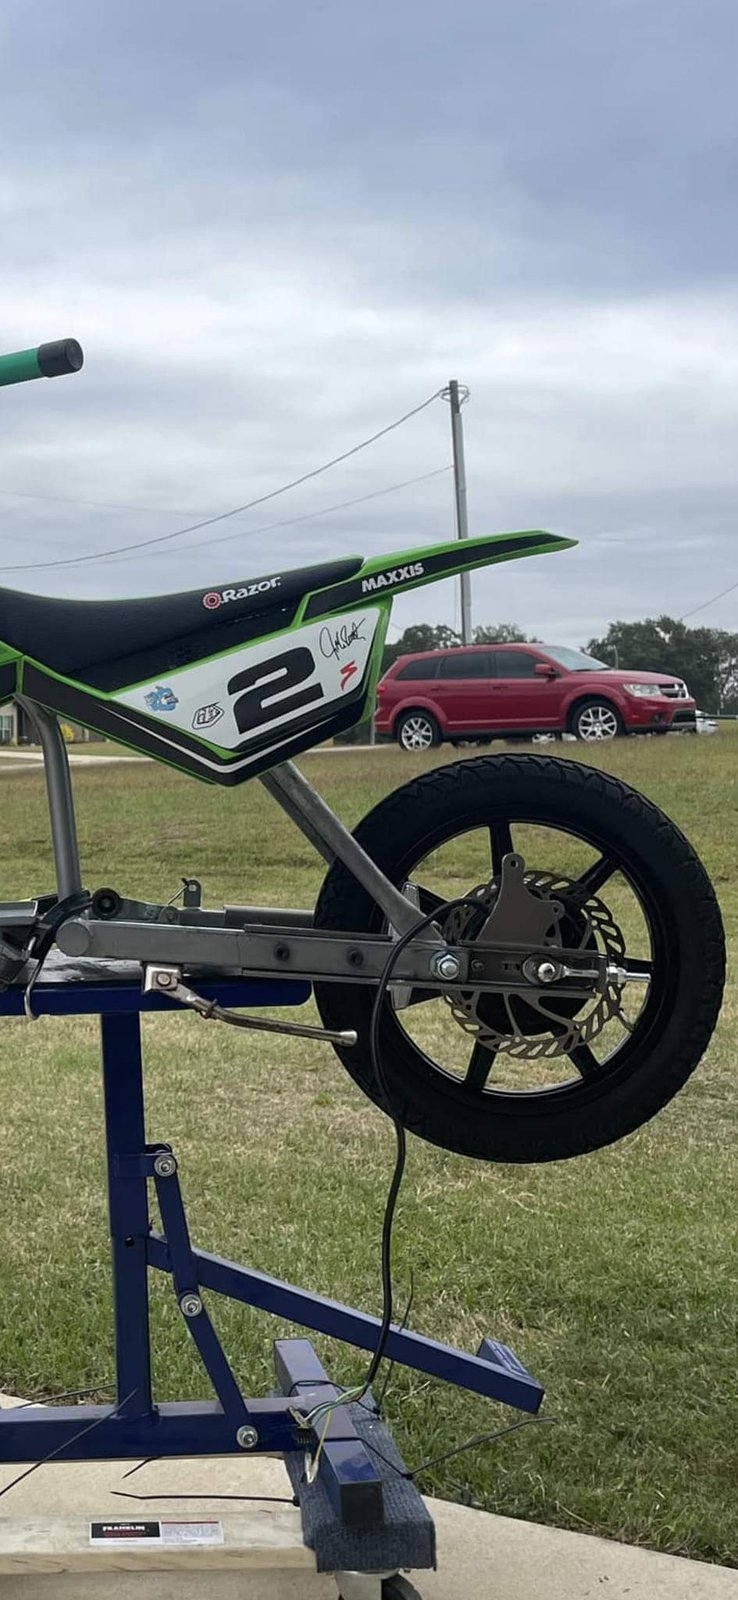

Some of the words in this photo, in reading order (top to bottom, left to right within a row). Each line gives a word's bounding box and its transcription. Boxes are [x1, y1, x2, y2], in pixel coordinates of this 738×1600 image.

[221, 577, 280, 604] Razor
[361, 563, 424, 592] MAXXIS
[227, 646, 325, 735] 2
